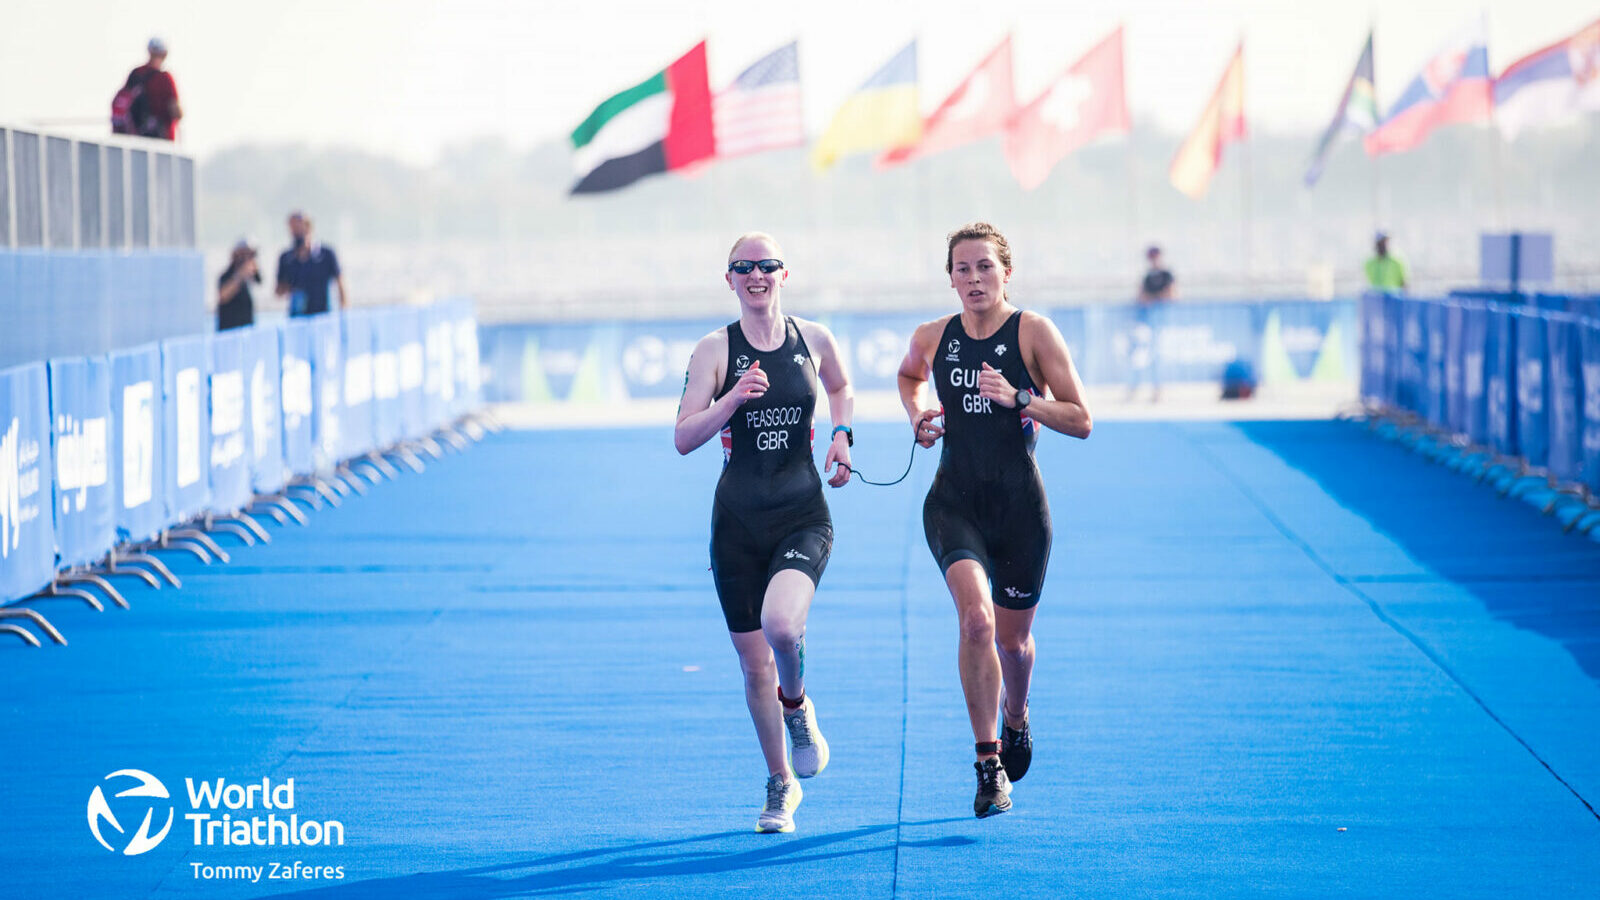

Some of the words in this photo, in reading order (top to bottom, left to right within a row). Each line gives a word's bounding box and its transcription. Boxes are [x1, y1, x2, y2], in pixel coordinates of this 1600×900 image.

[950, 367, 1002, 388] GUI
[962, 394, 992, 414] GBR
[745, 407, 802, 429] PEASGOOD
[756, 430, 789, 451] GBR
